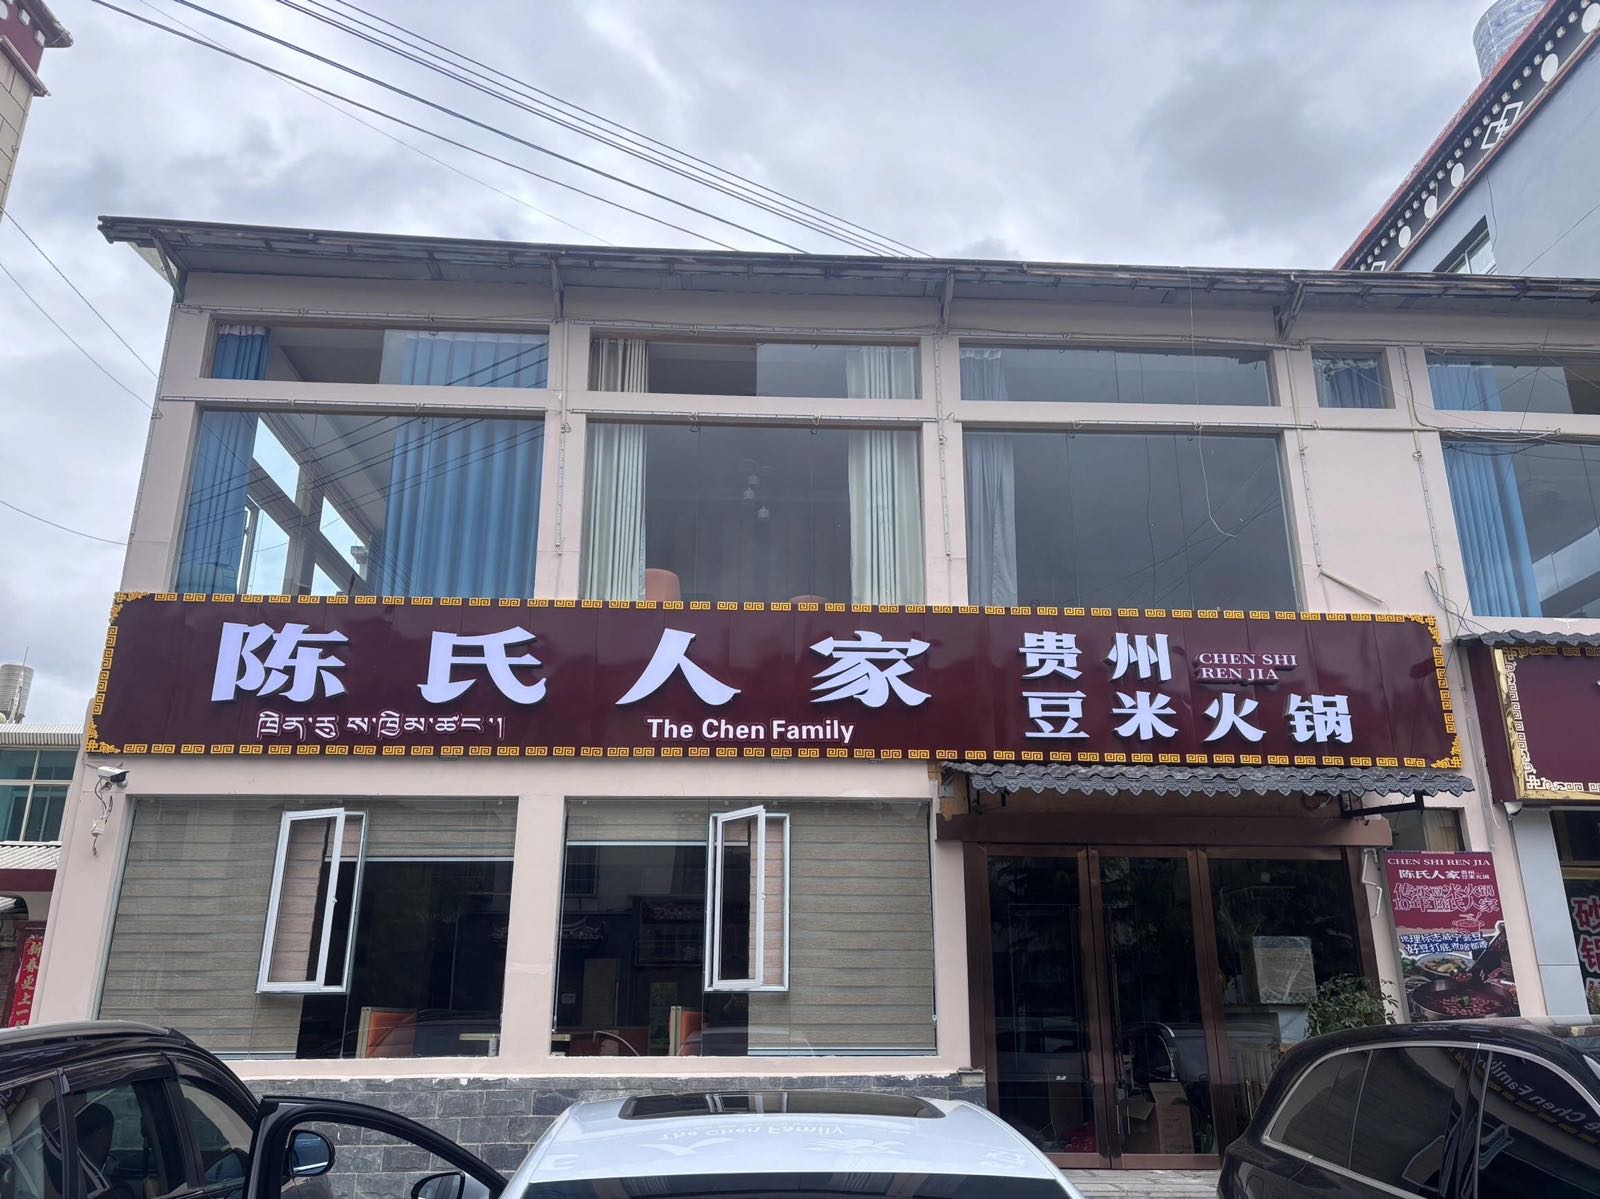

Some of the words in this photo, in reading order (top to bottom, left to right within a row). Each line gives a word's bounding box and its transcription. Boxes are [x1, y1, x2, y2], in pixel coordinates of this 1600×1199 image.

[210, 622, 932, 707] 陈氏人家
[1018, 630, 1172, 682] 贵州
[1199, 653, 1256, 665] CHEN
[1262, 654, 1298, 666] SHI
[1201, 667, 1243, 679] REN
[1247, 668, 1280, 681] JIA
[1022, 690, 1354, 744] 豆米火锅
[647, 718, 694, 739] The
[702, 718, 765, 740] Chen
[772, 719, 854, 744] Family
[1423, 858, 1444, 866] SHI
[1472, 859, 1491, 867] JIA
[1399, 869, 1461, 880] 陈氏人家
